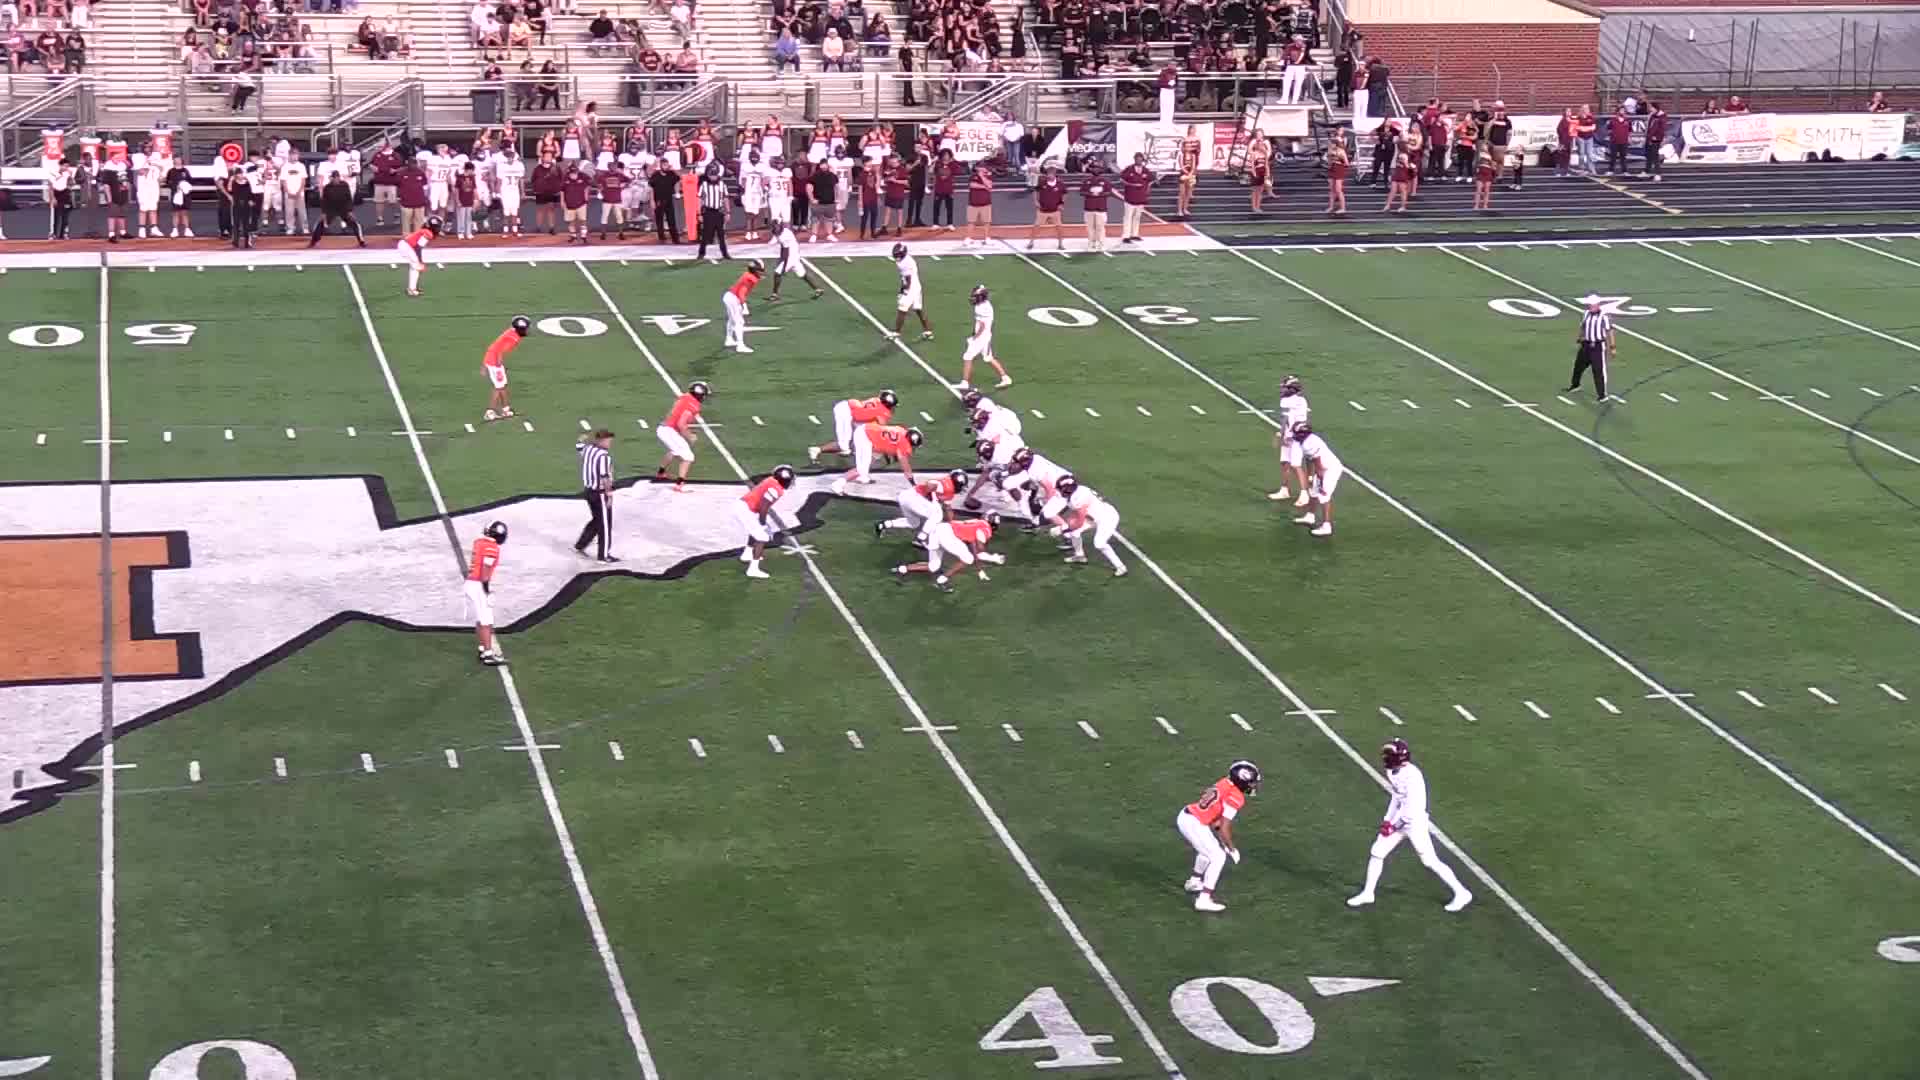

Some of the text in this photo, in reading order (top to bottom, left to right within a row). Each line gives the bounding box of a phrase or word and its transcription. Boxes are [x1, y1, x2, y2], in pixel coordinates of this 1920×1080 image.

[1803, 127, 1862, 144] SMITH
[536, 314, 711, 337] 40
[1027, 305, 1200, 325] 30
[8, 323, 198, 347] 50
[979, 976, 1316, 1069] 40
